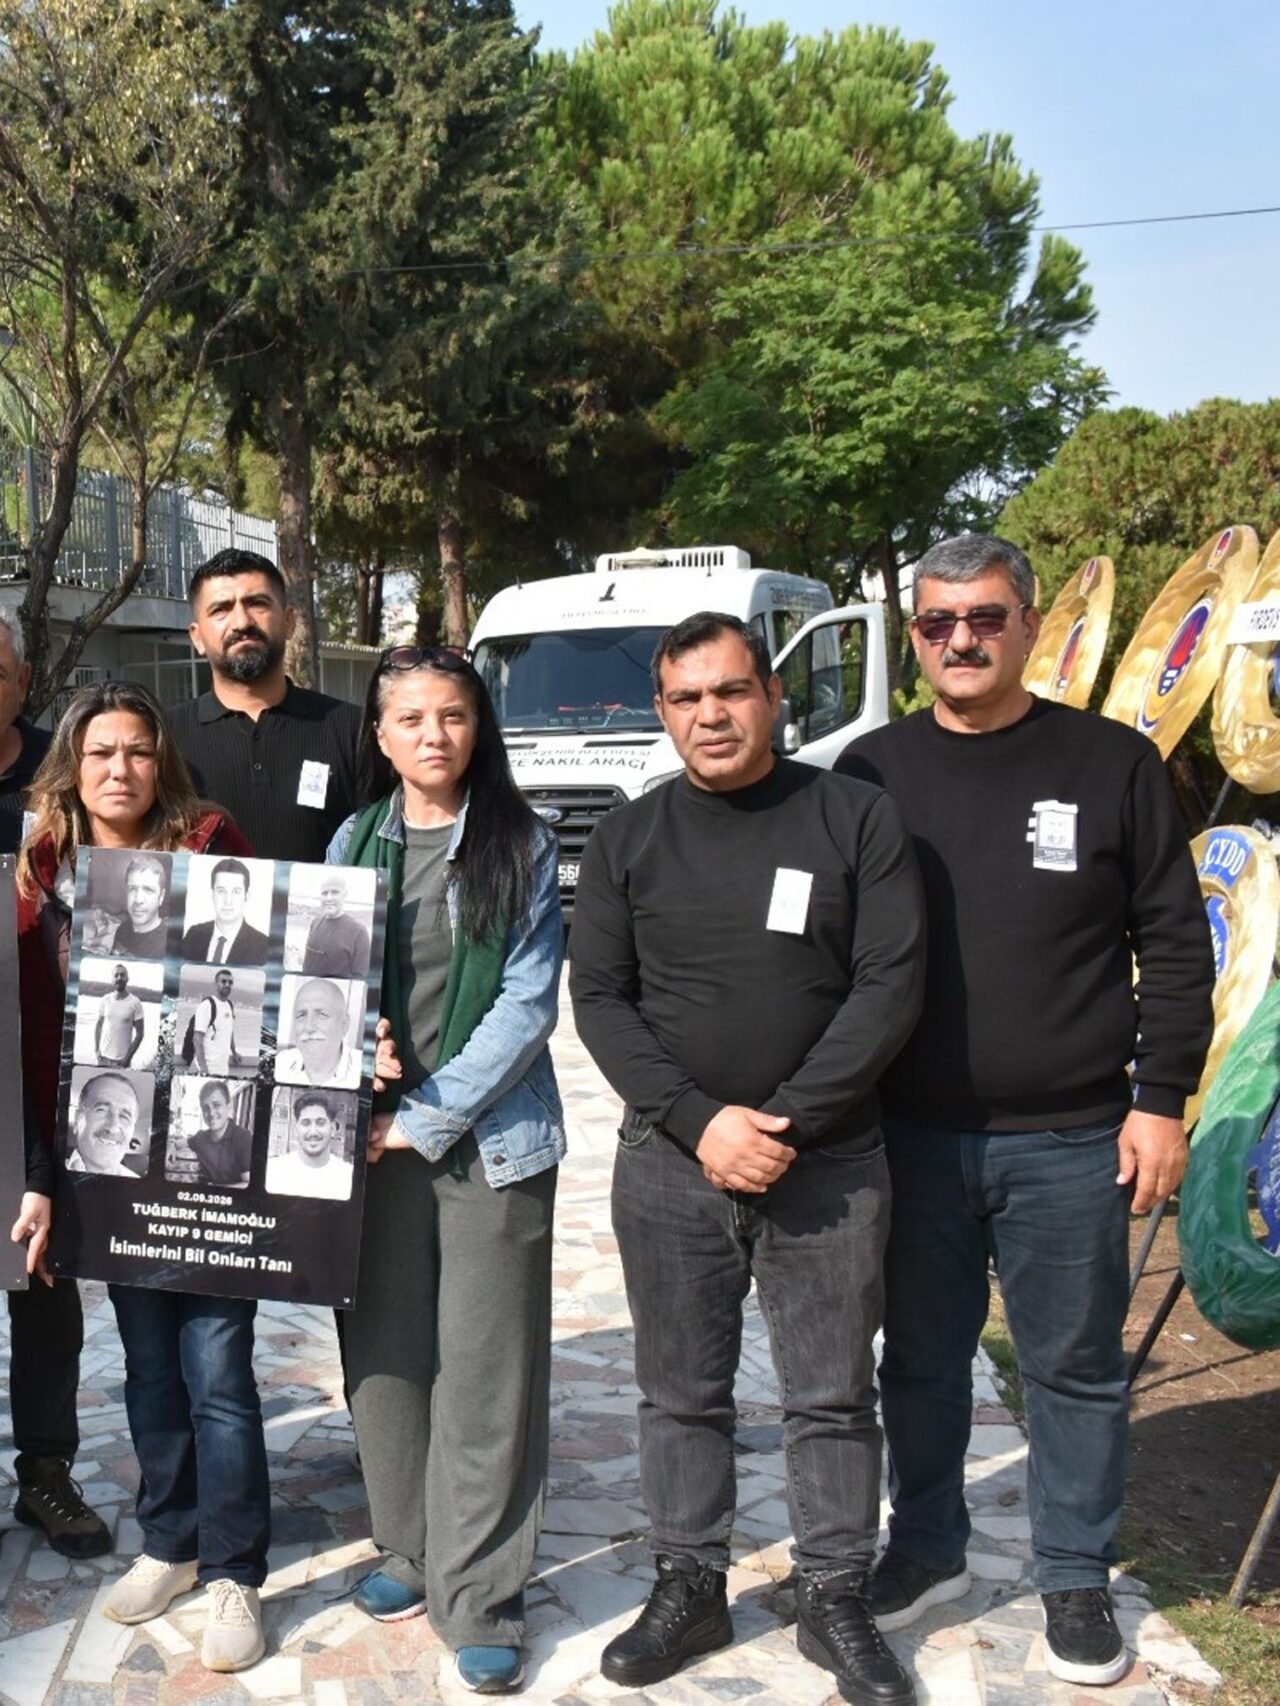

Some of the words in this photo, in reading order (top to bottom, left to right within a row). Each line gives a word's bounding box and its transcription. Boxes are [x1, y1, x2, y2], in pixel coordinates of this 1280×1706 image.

[132, 1203, 198, 1220] TUĞBERK
[201, 1208, 276, 1228] İMAMOĞLU
[148, 1223, 189, 1238] KAYIP
[192, 1228, 200, 1239] 9
[204, 1229, 253, 1245] GEMİCİ
[110, 1237, 181, 1260] İsimlerini
[185, 1249, 204, 1263] Bil
[208, 1251, 255, 1269] Onları
[259, 1256, 292, 1272] Tanı
